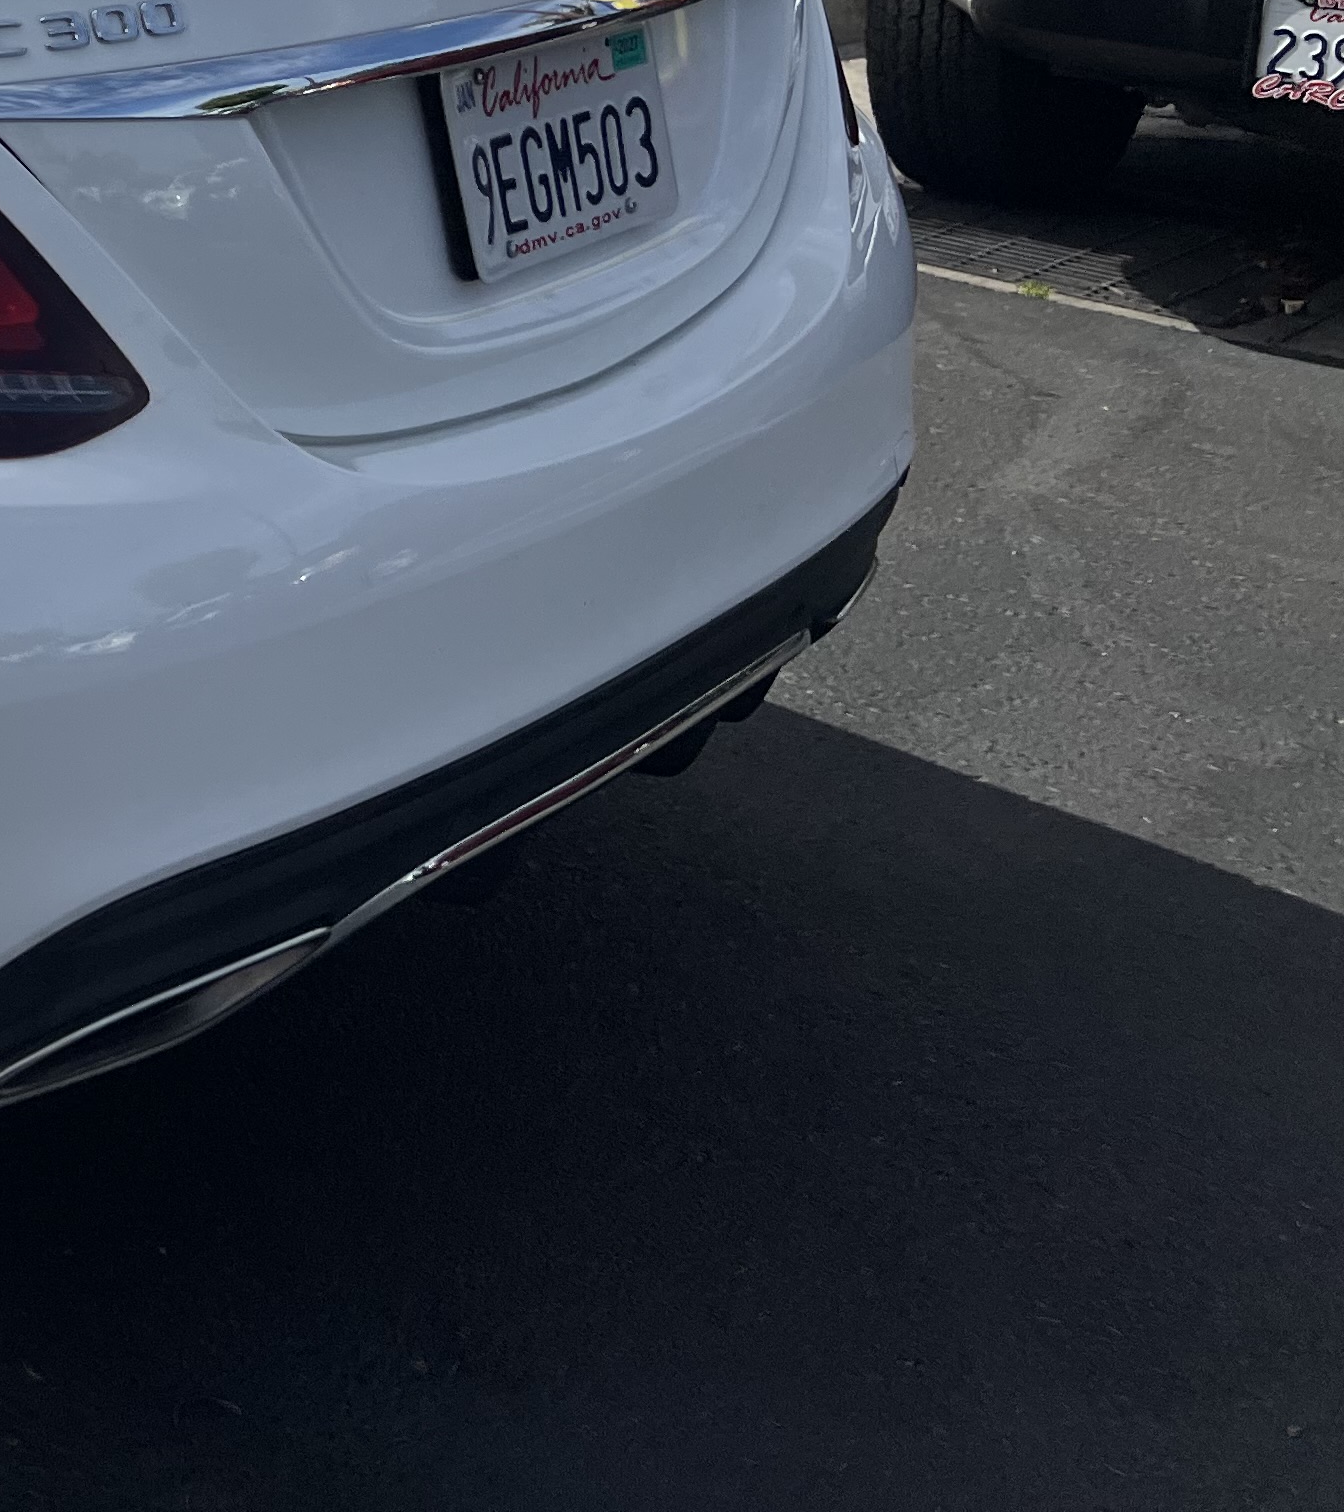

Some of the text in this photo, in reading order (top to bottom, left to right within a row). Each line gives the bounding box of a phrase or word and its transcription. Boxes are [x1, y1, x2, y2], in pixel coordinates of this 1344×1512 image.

[481, 56, 616, 119] California
[472, 96, 659, 246] 9EGM503
[518, 206, 622, 256] dmv.ca.gov
